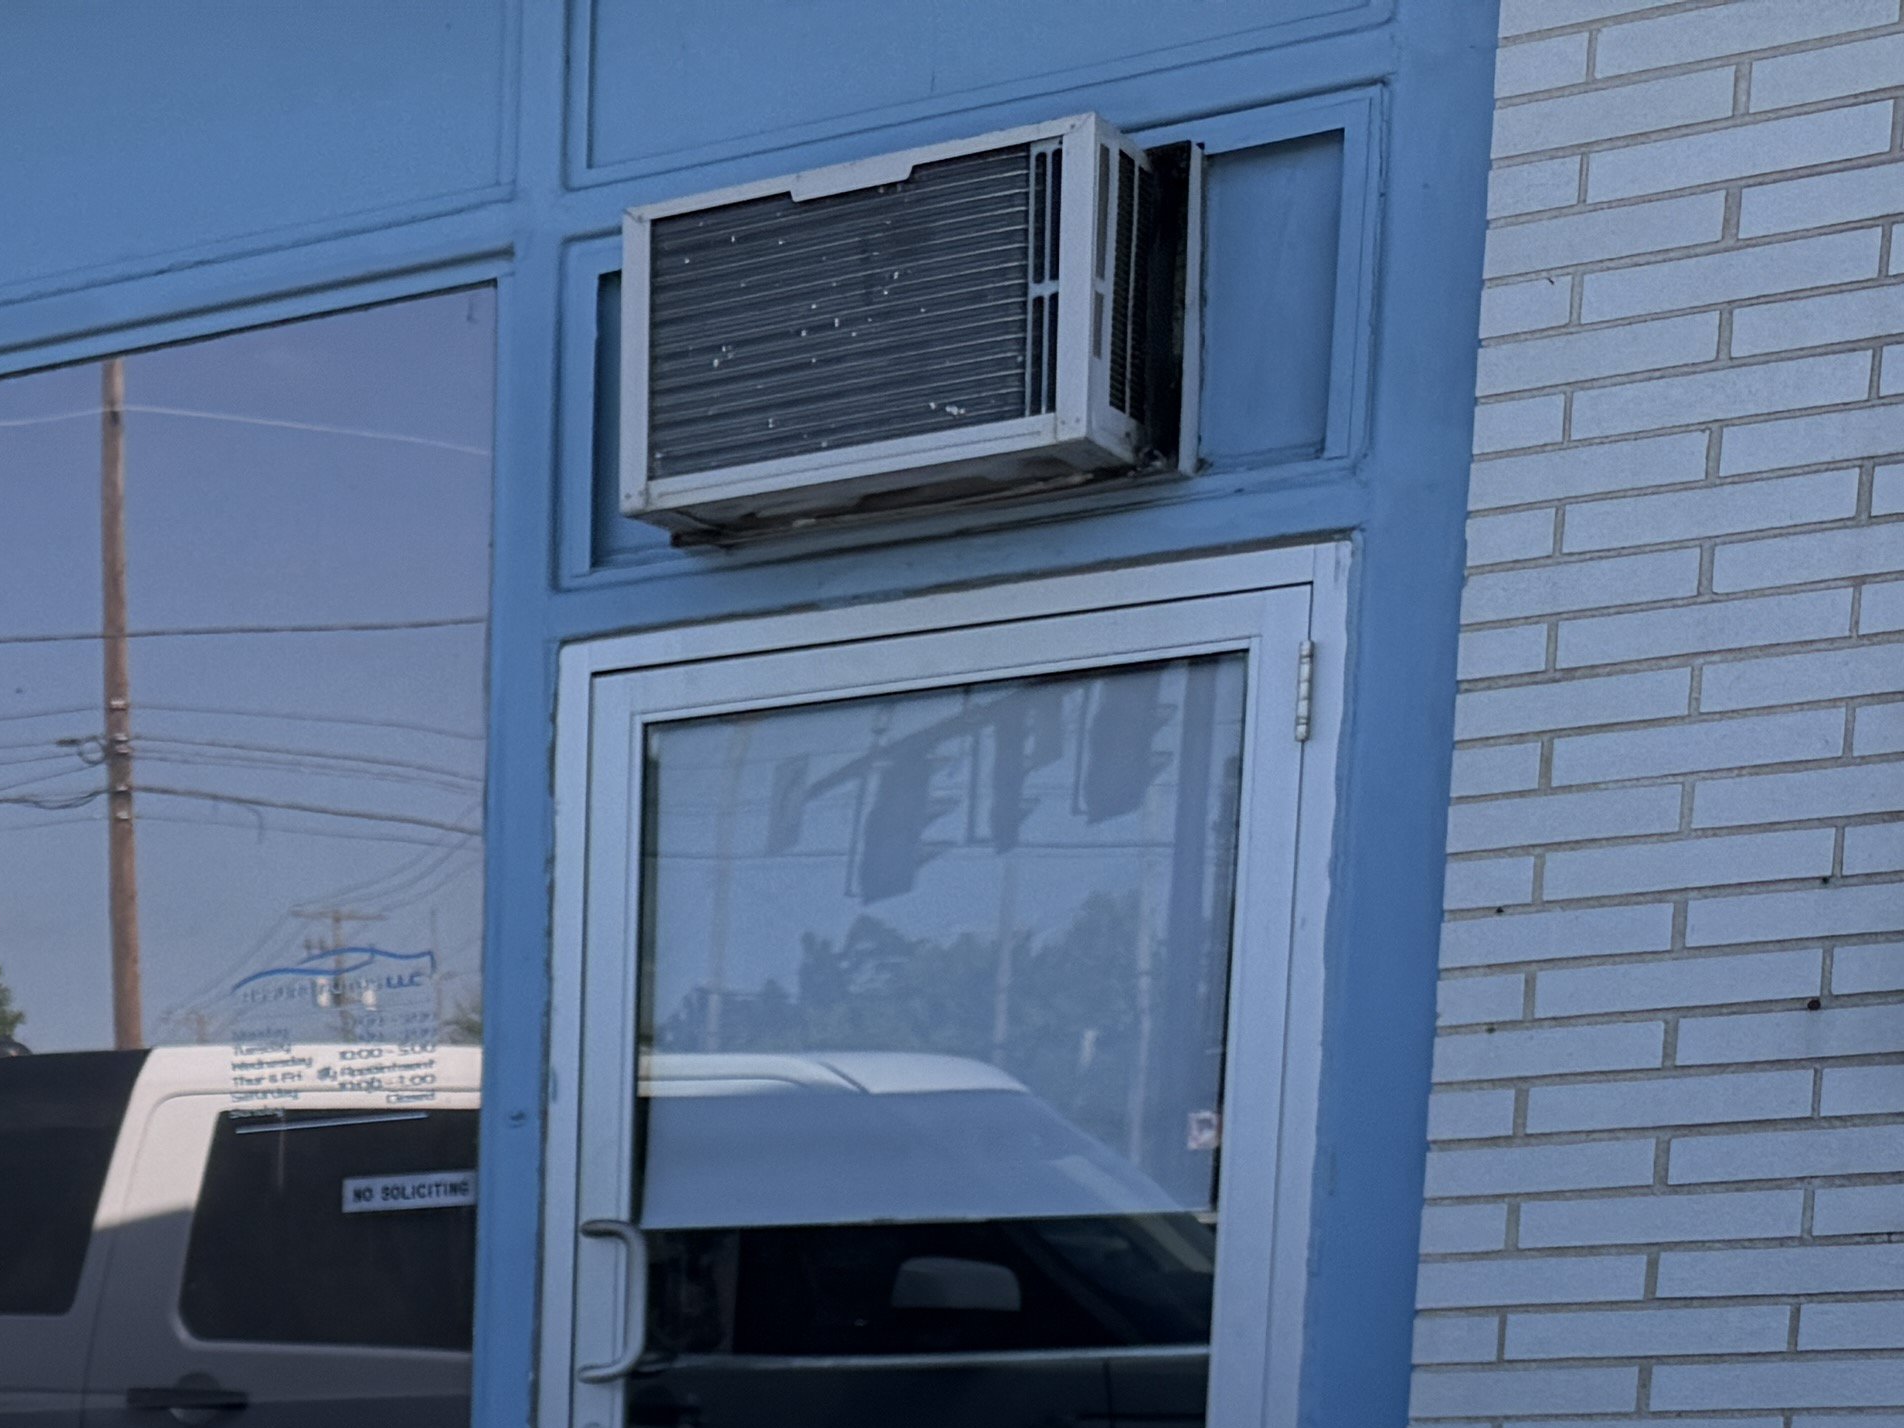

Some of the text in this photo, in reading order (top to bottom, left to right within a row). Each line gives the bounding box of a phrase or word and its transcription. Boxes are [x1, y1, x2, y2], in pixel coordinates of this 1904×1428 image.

[231, 1057, 312, 1071] Wednesday
[340, 1058, 435, 1077] Appointment
[352, 1180, 470, 1203] NO SOLICITING
